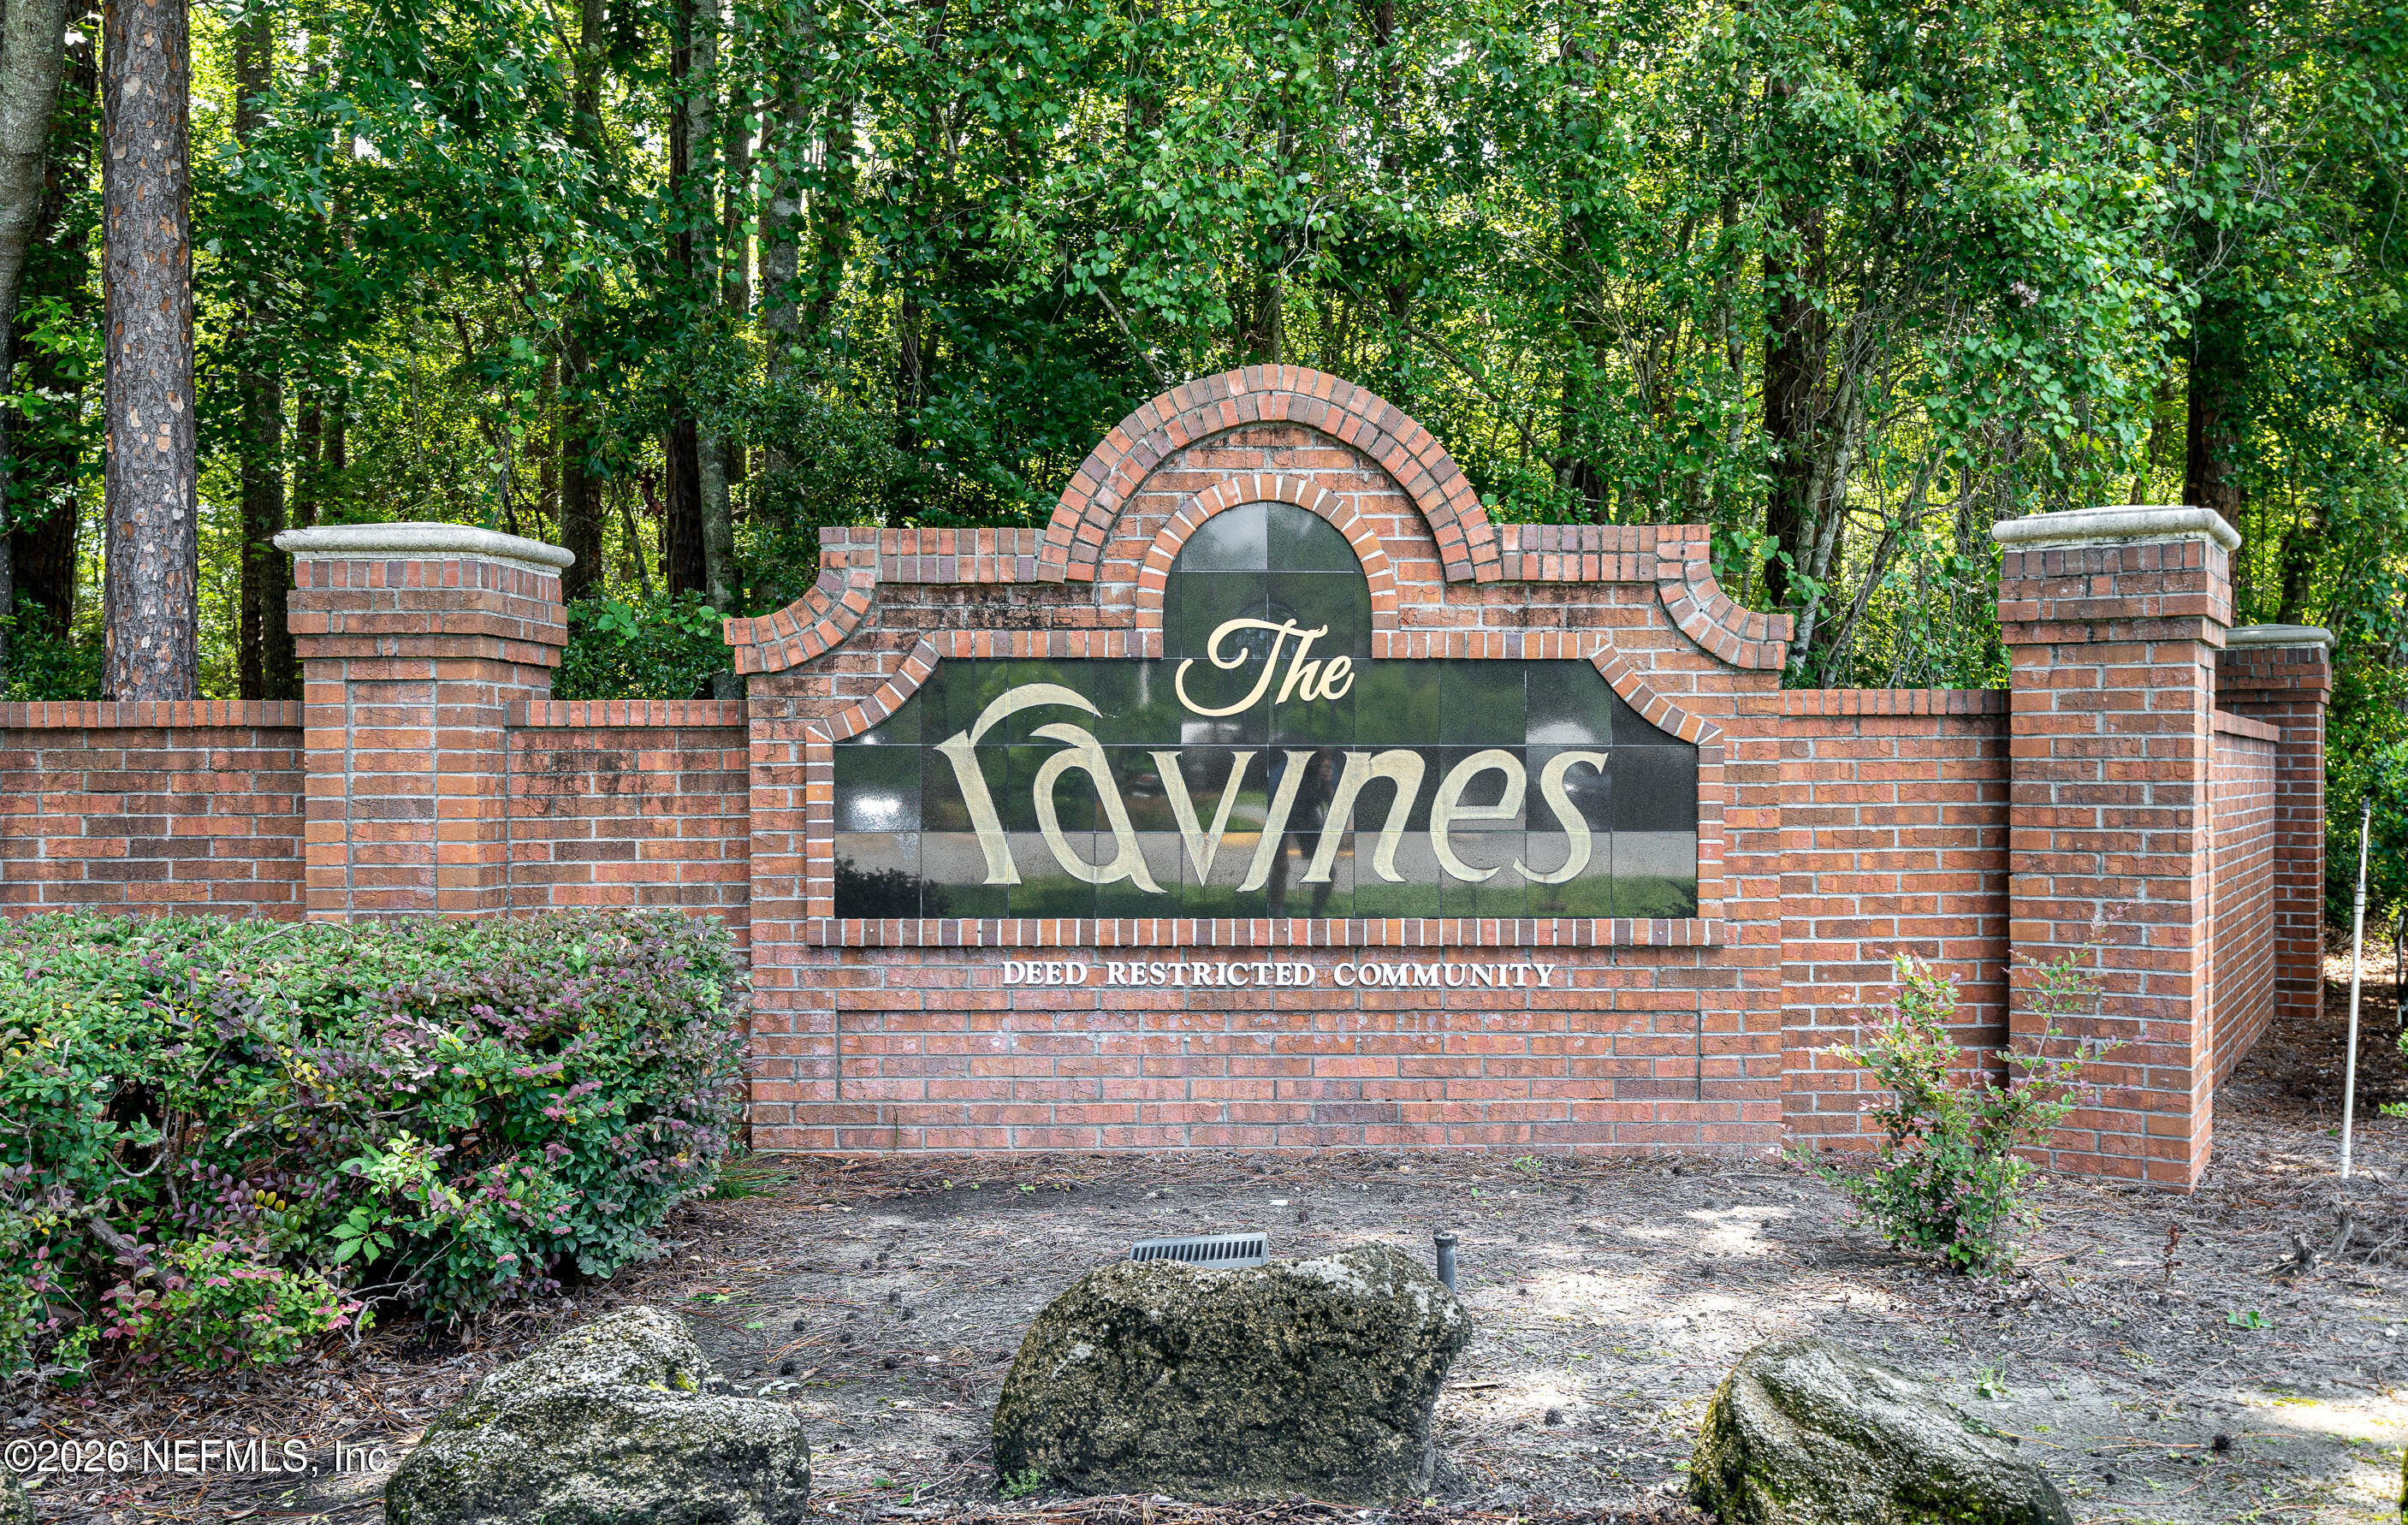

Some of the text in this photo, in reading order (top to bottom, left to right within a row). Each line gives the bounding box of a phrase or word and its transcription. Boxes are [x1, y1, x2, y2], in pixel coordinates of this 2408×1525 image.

[1175, 618, 1355, 717] The
[1002, 960, 1557, 988] DEED RESTRICTED COMMUNITY
